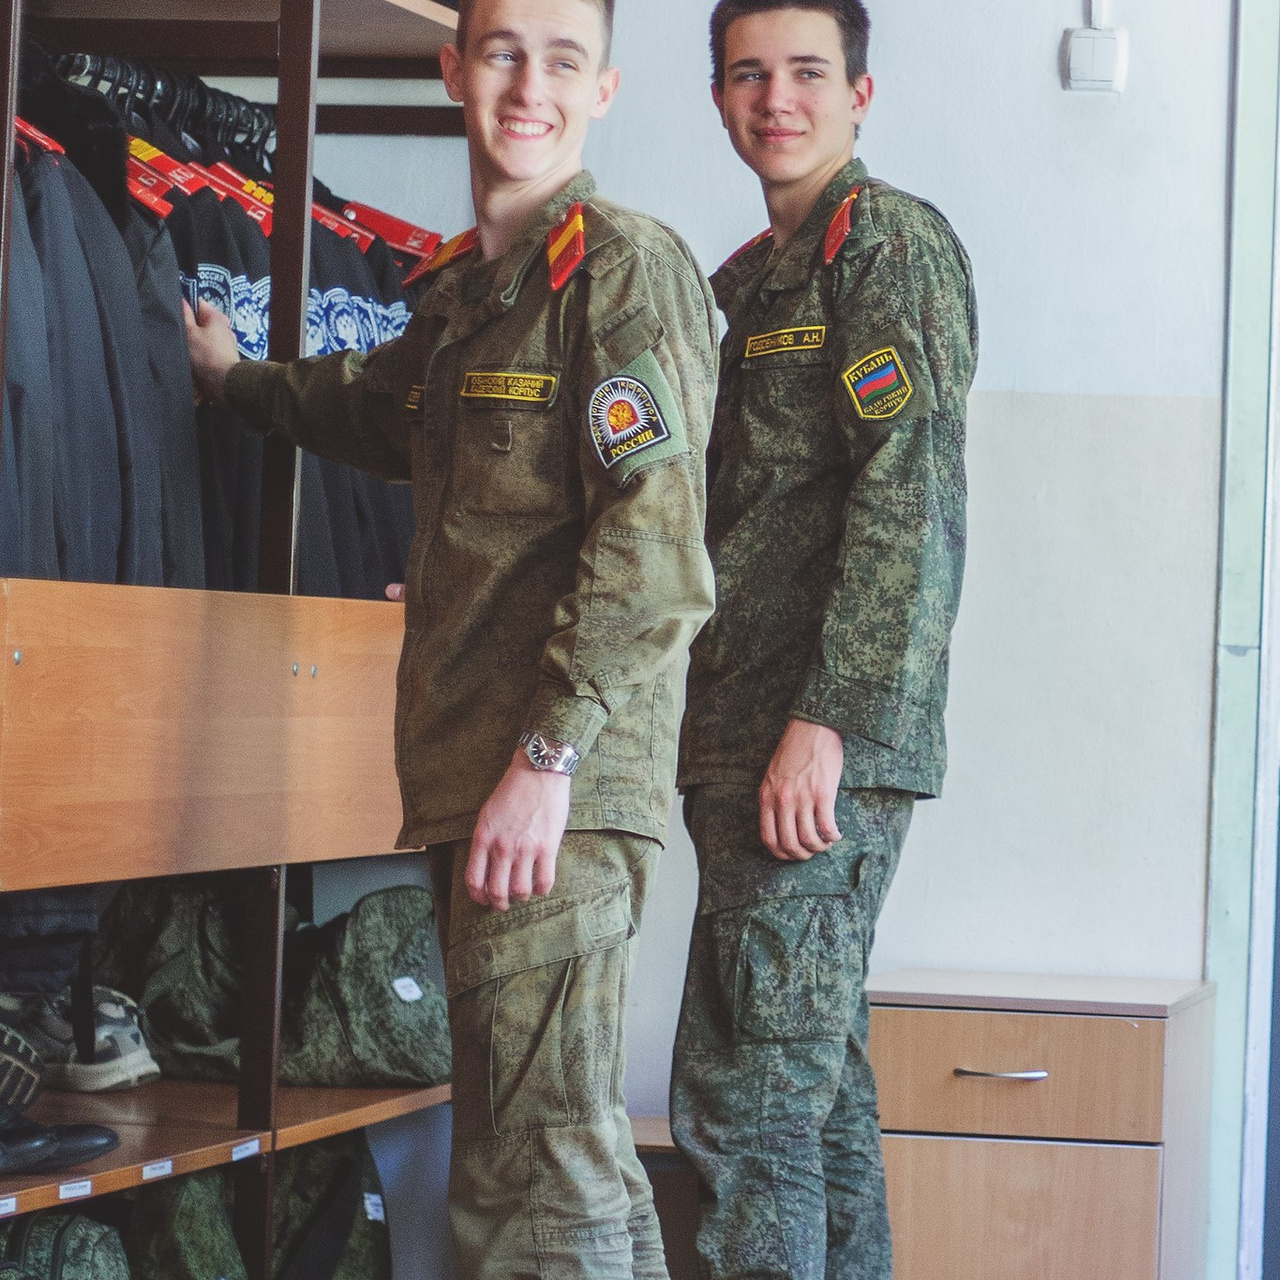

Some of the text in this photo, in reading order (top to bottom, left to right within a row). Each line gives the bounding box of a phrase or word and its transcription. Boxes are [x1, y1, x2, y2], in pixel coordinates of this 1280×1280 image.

[197, 271, 224, 283] ОССИЯ
[848, 353, 893, 383] КУБАНЬ
[508, 386, 541, 398] КОРПУС
[610, 429, 655, 458] РОССИИ
